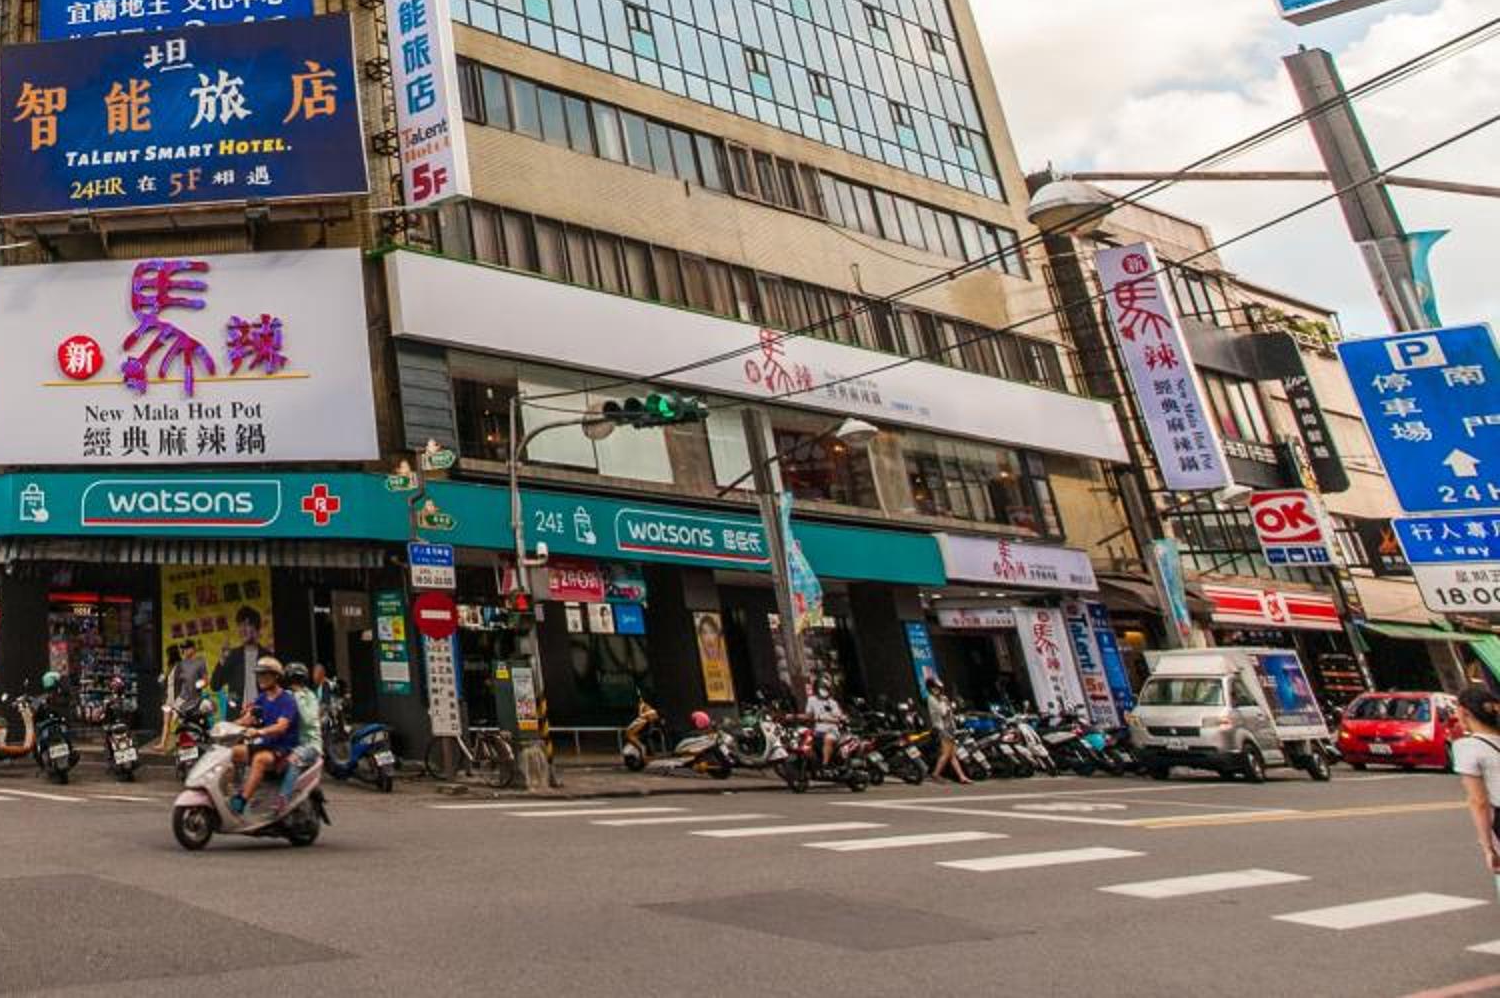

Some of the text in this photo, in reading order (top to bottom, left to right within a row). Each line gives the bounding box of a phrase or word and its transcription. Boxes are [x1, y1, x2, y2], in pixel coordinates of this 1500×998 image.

[16, 60, 337, 152] 智能旅店
[145, 142, 214, 162] SMART
[70, 177, 126, 201] 24HR
[169, 168, 201, 195] 5F
[413, 163, 448, 201] 5F
[64, 339, 94, 373] 新
[1397, 341, 1429, 366] P
[84, 401, 262, 423] New Mala Hot Pot
[1371, 372, 1434, 443] 停車場
[83, 423, 267, 457] 經典麻辣鍋
[107, 489, 254, 515] watsons
[1255, 501, 1317, 533] OK
[627, 519, 714, 547] watsons
